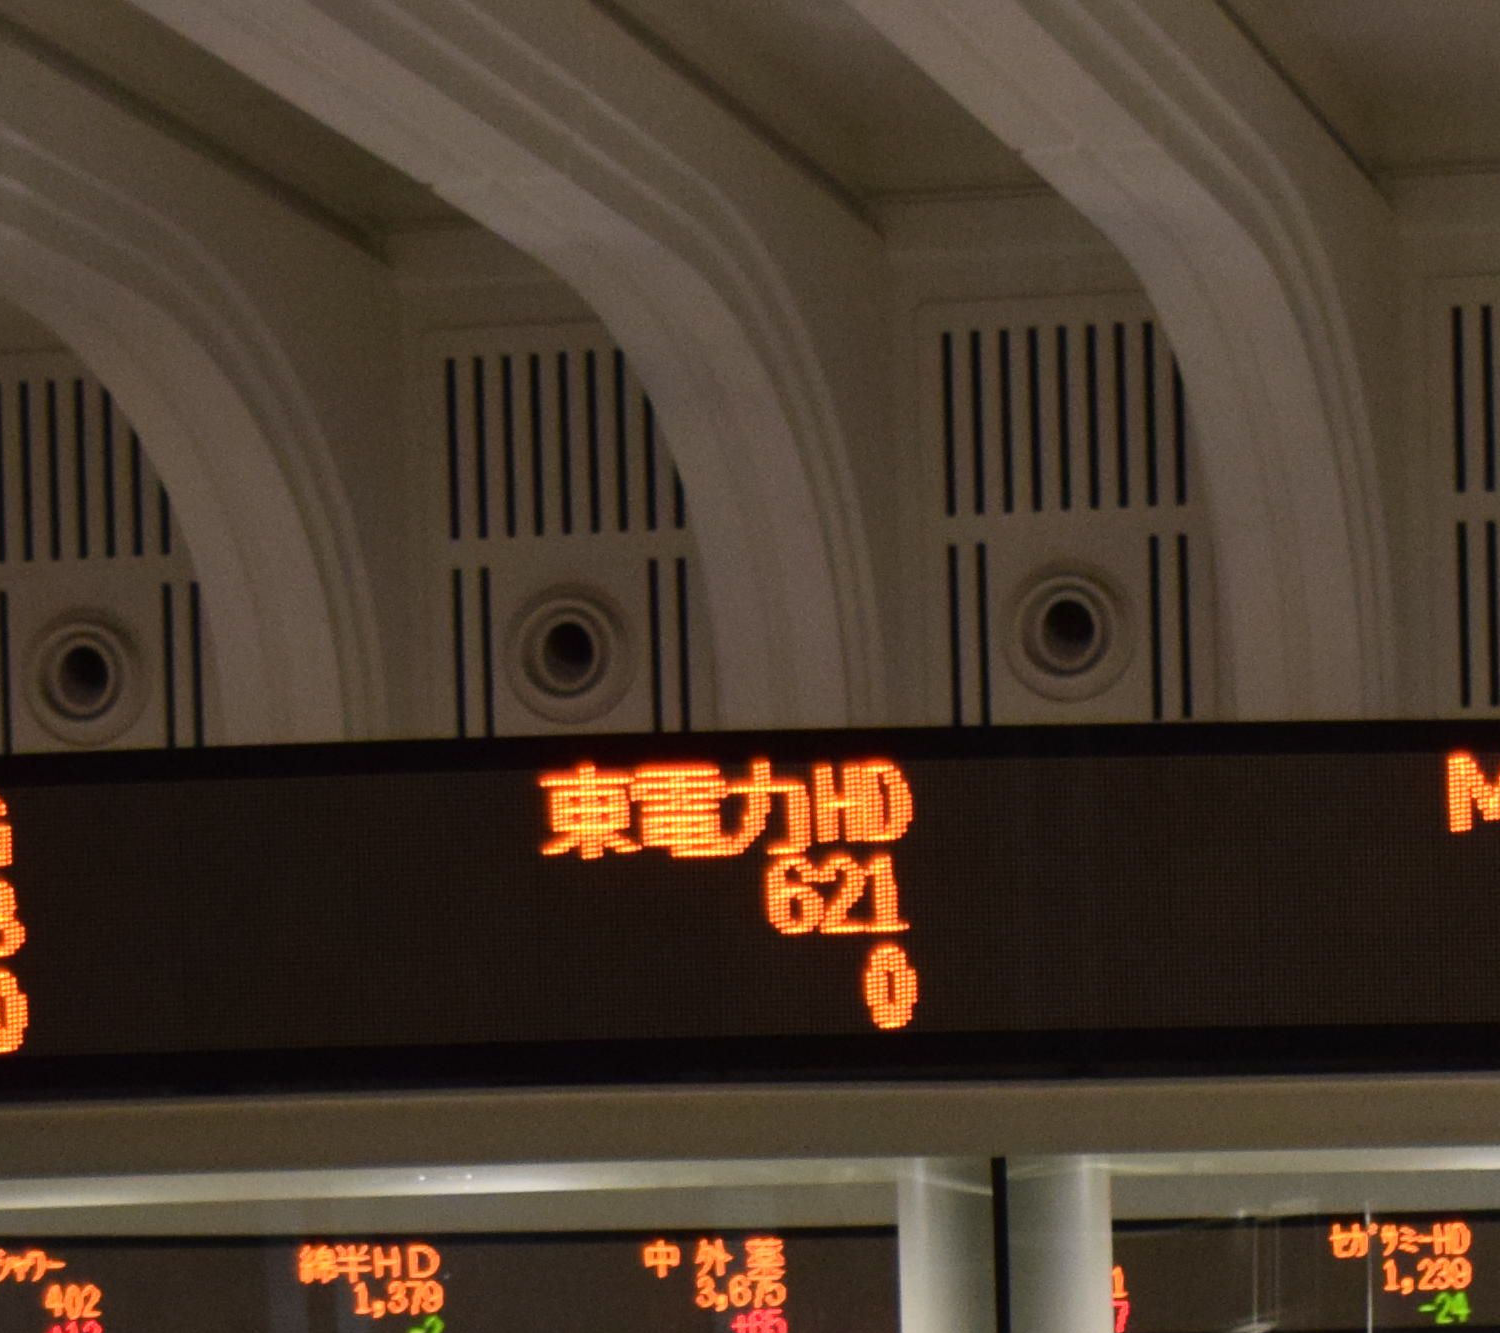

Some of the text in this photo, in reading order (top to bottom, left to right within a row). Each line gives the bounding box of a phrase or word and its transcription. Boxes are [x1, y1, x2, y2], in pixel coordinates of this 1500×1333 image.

[540, 760, 912, 860] 東電力HD
[766, 855, 909, 934] 621
[863, 942, 918, 1029] 0
[297, 1244, 441, 1284] 綿半HD
[1383, 1257, 1472, 1295] 1,239
[44, 1284, 101, 1321] 402
[354, 1280, 444, 1318] 1,379
[695, 1275, 787, 1312] 3,675
[1417, 1292, 1471, 1324] -24
